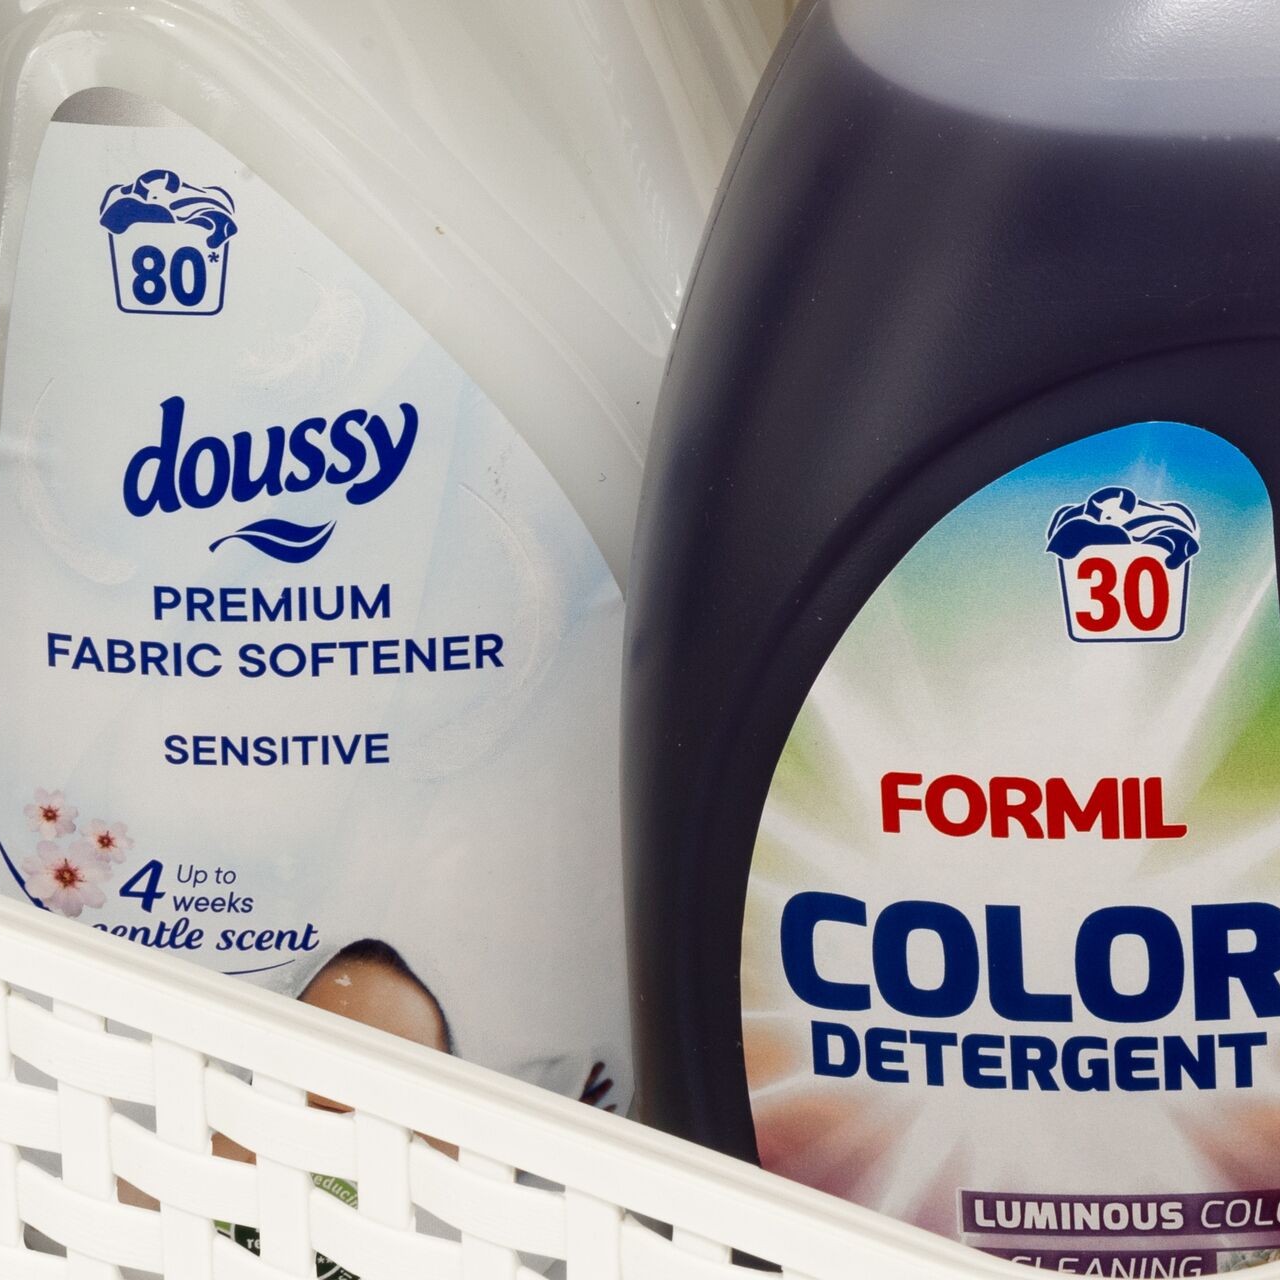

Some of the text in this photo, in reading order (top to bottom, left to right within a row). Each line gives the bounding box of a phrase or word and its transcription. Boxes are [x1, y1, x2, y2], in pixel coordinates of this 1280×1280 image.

[123, 396, 418, 517] doussy
[154, 584, 390, 621] PREMIUM
[1076, 557, 1168, 631] 30
[47, 633, 503, 678] FABRIC SOFTENER
[165, 734, 389, 765] SENSITIVE
[880, 771, 1188, 840] FORMIL
[119, 859, 166, 913] 4
[177, 864, 237, 888] Up to
[173, 892, 254, 913] weeks
[93, 917, 320, 951] entle scent
[811, 1020, 1267, 1092] DETERGENT
[974, 1199, 1184, 1231] LUMINOUS
